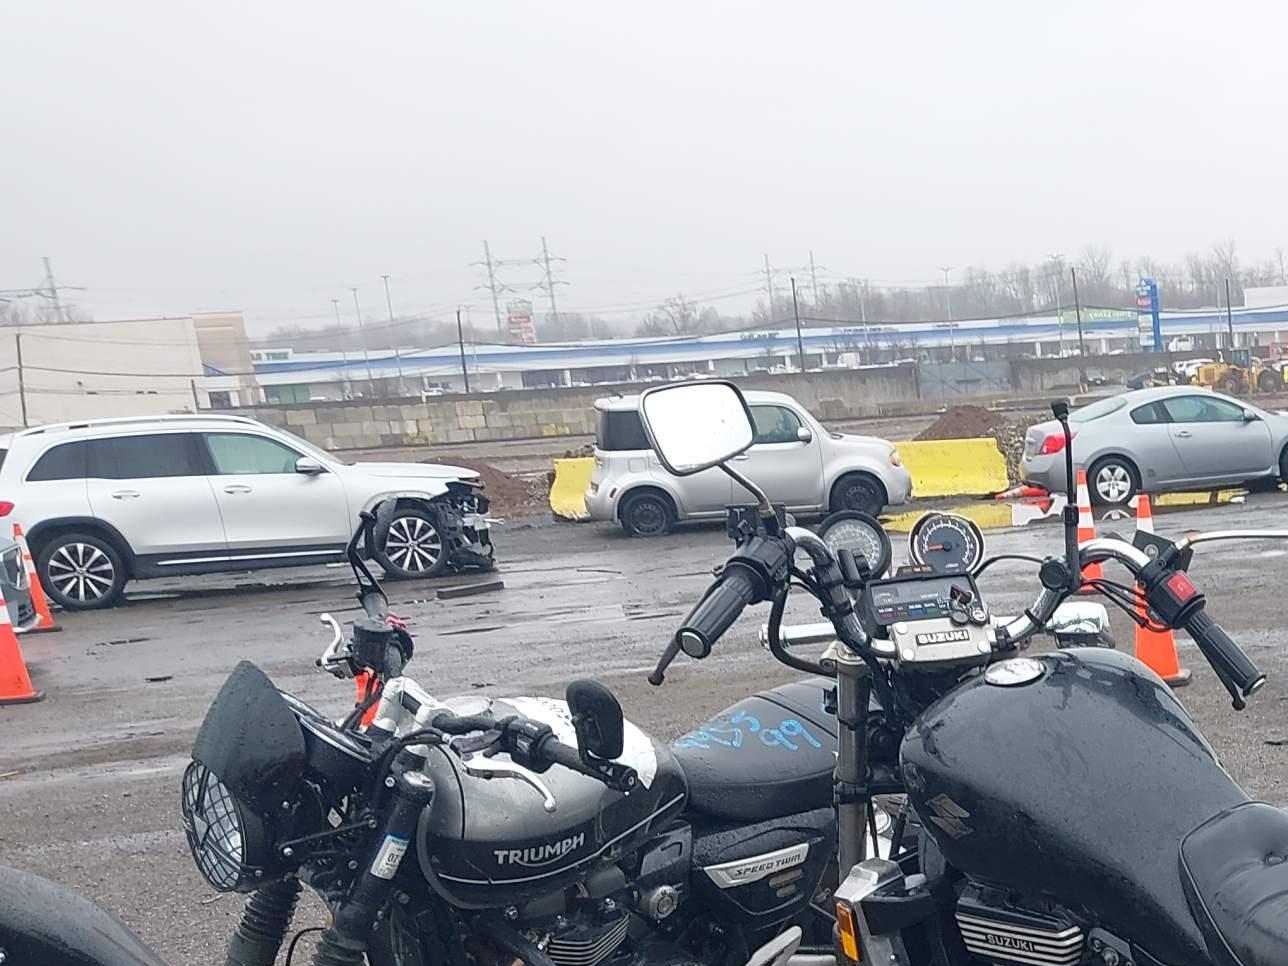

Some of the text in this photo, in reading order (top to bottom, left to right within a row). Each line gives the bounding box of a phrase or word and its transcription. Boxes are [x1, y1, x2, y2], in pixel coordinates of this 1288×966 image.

[917, 630, 969, 645] SUZUKI
[493, 832, 585, 866] TRIUMPH
[734, 853, 801, 877] SPEED TWIN
[986, 933, 1035, 952] SUZUKI
